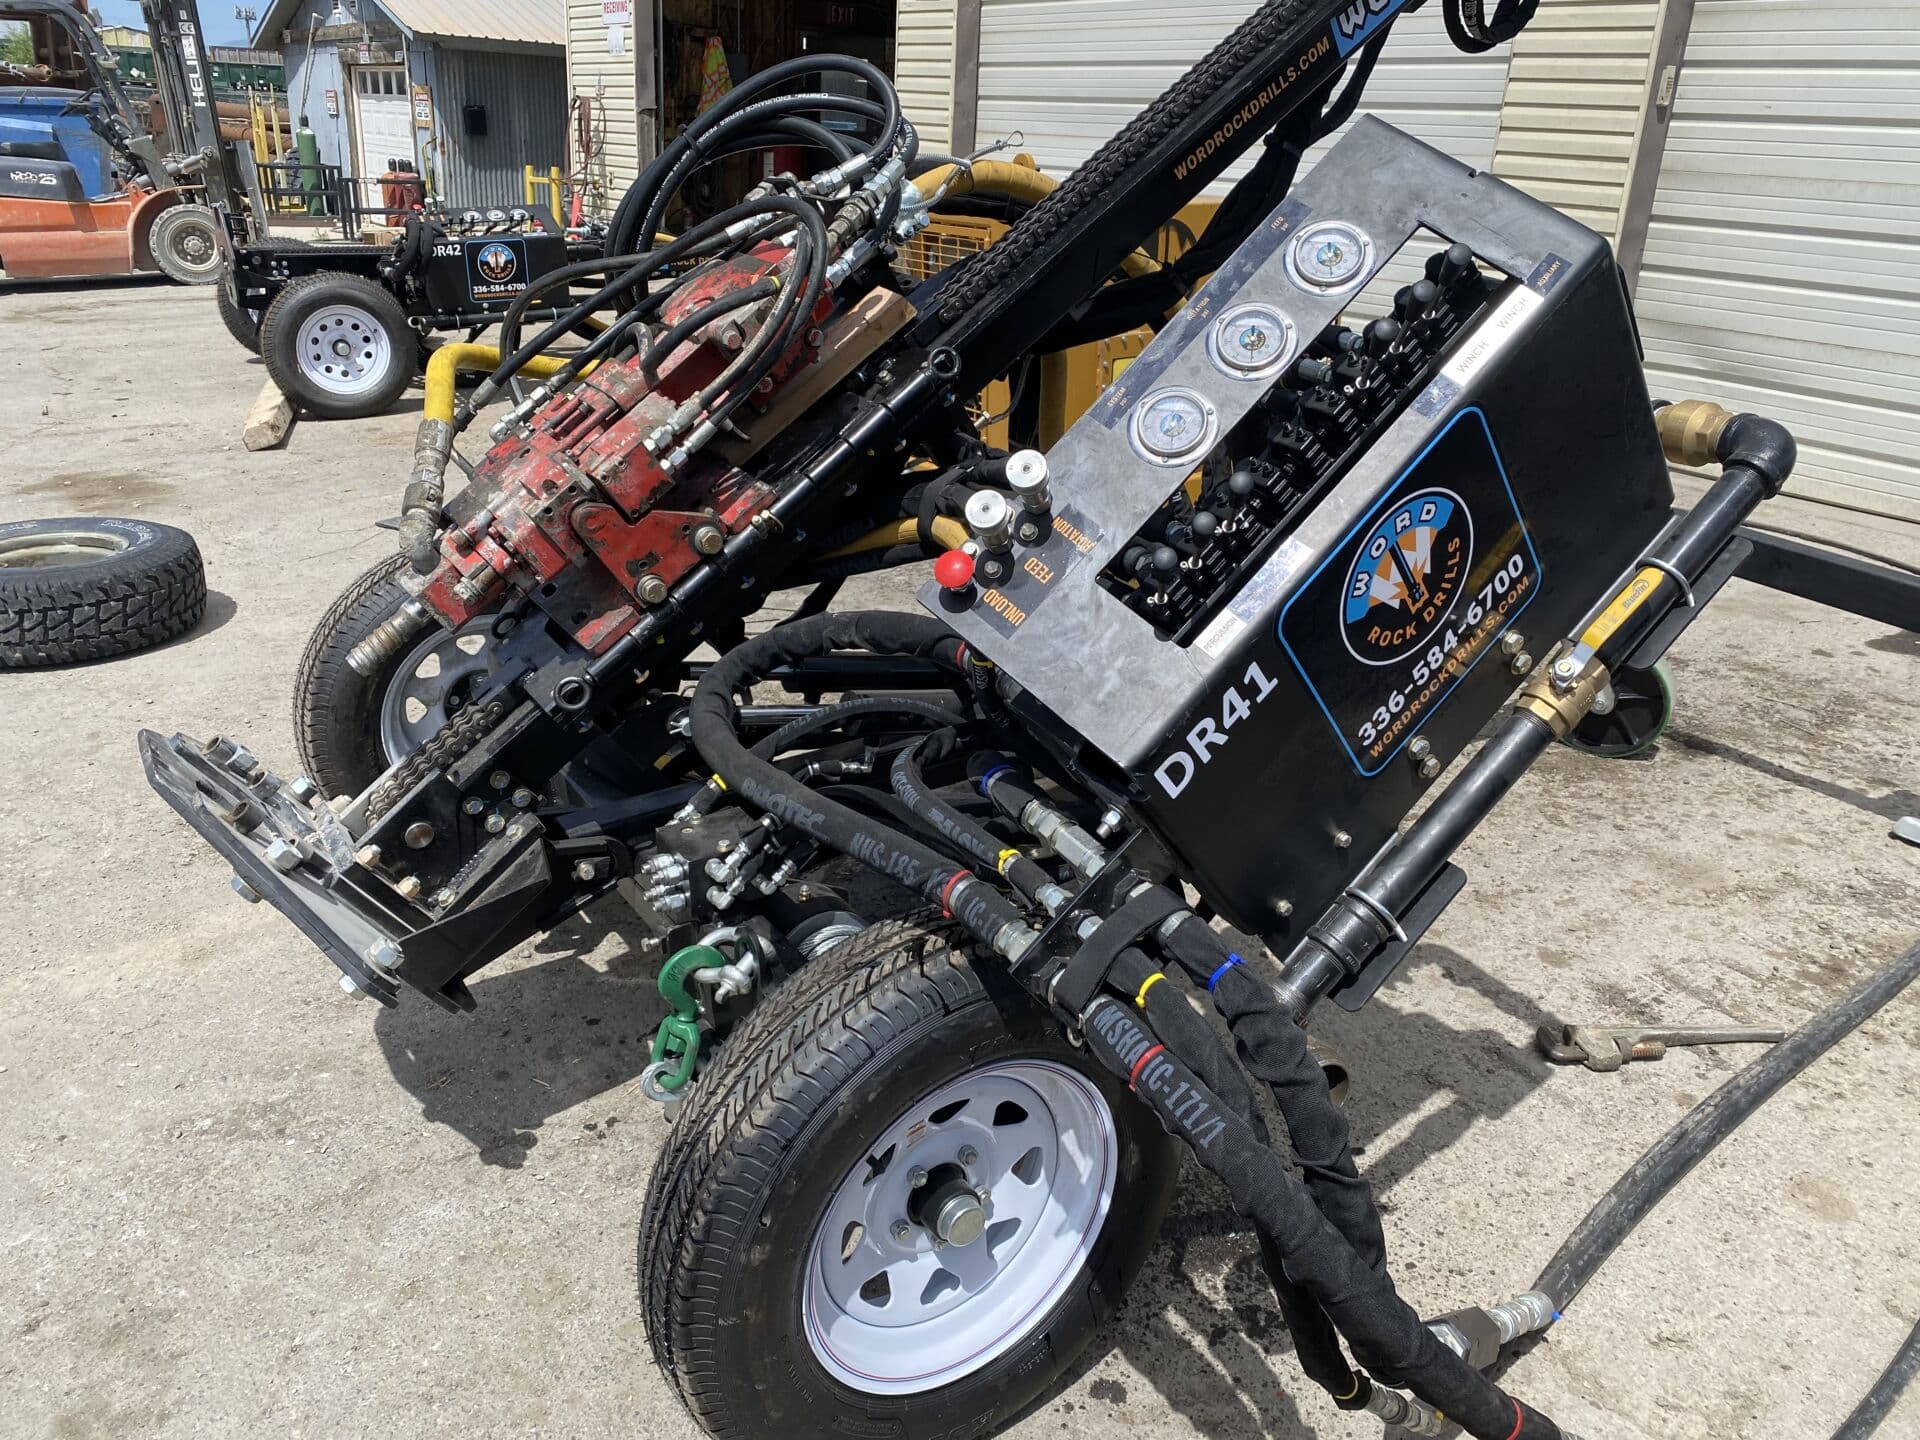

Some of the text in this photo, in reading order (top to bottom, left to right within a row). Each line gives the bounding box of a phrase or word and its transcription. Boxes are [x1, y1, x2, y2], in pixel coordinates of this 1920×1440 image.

[1173, 36, 1331, 181] WORDROCKDRILLS.COM
[473, 283, 527, 294] 336-584-6700
[1497, 297, 1530, 330] WINCH
[1456, 341, 1490, 374] WINCH
[1023, 557, 1055, 585] FEED
[1051, 515, 1098, 555] ROTATION
[1352, 502, 1438, 598] WORD
[983, 588, 1026, 628] UNLOAD
[1367, 536, 1461, 648] ROCK DRILLS
[1358, 553, 1525, 747] 336-584-6700
[1368, 574, 1531, 759] WORDROCKDRILLS.COM
[1153, 660, 1279, 800] DR41
[1093, 1004, 1151, 1070] MSHA
[1141, 1054, 1227, 1149] IC-171/1
